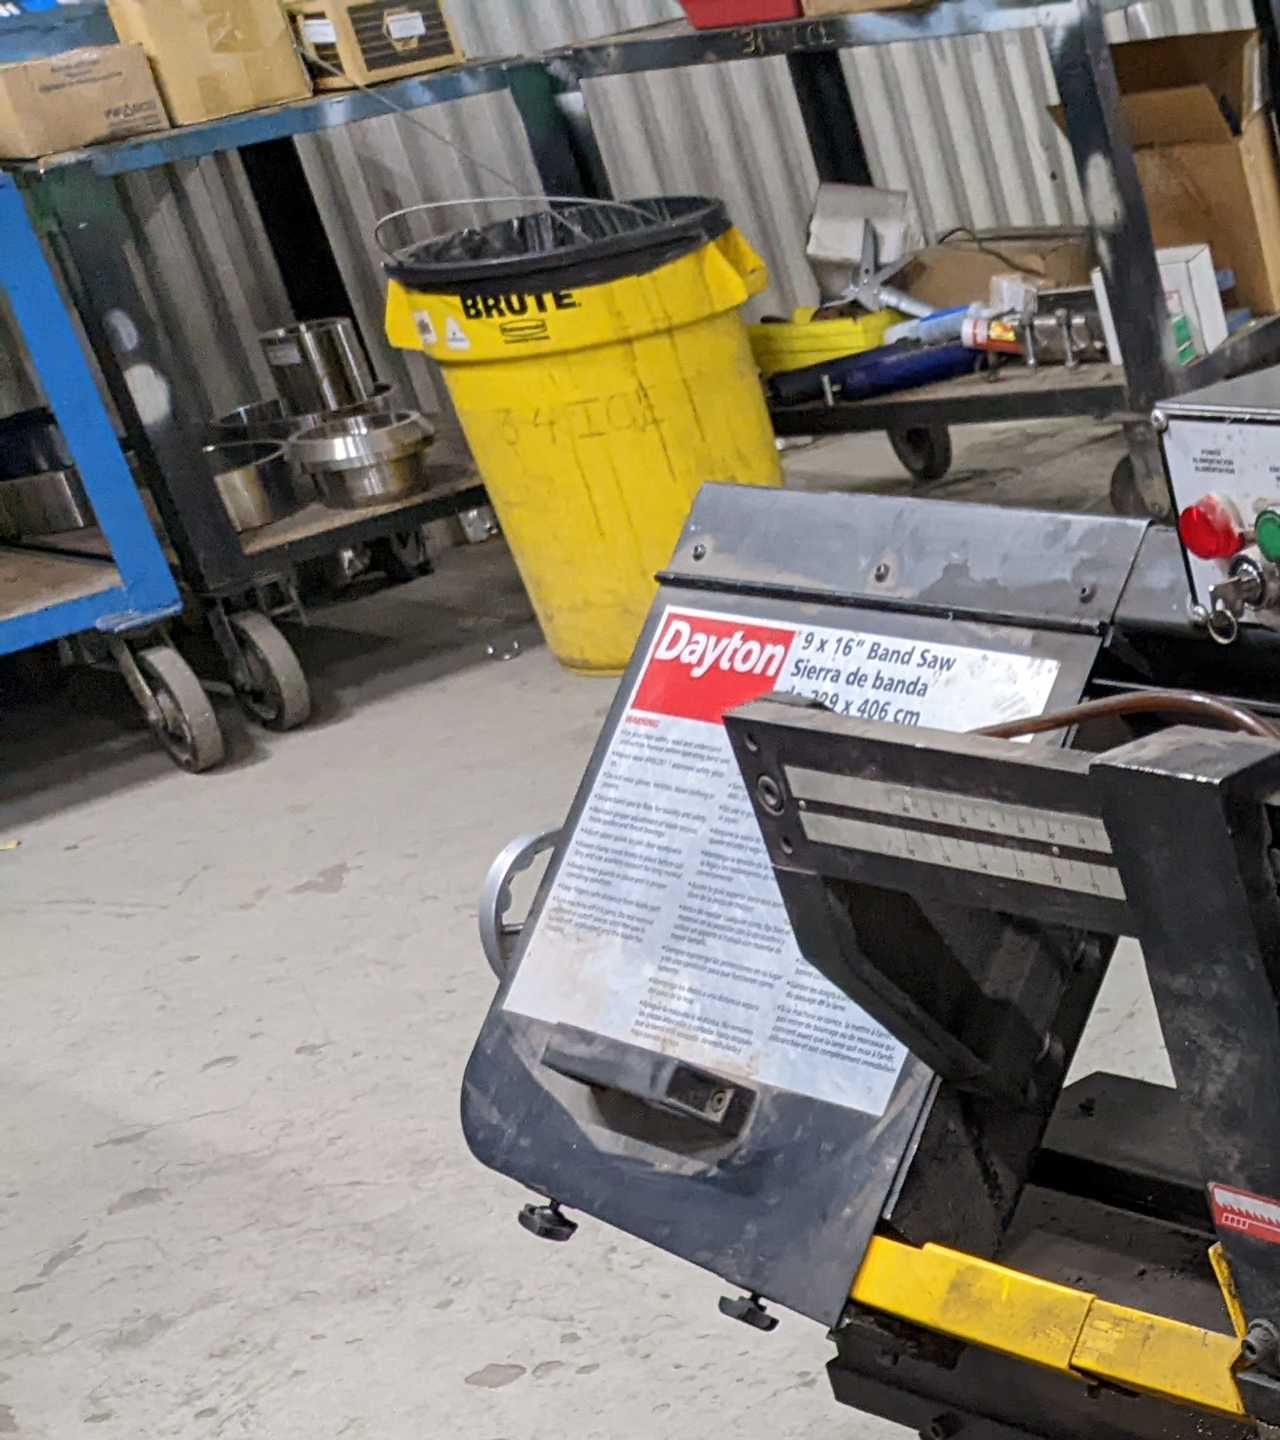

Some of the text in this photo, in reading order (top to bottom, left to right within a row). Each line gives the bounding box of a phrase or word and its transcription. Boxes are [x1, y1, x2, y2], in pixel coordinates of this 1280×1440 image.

[655, 619, 786, 678] Dayton
[802, 631, 814, 650] 9
[817, 637, 829, 653] x
[866, 641, 916, 666] Band
[916, 649, 957, 672] Saw
[790, 658, 929, 698] Sierra de banda
[840, 699, 853, 716] x
[857, 698, 892, 721] 406
[893, 706, 921, 727] cm
